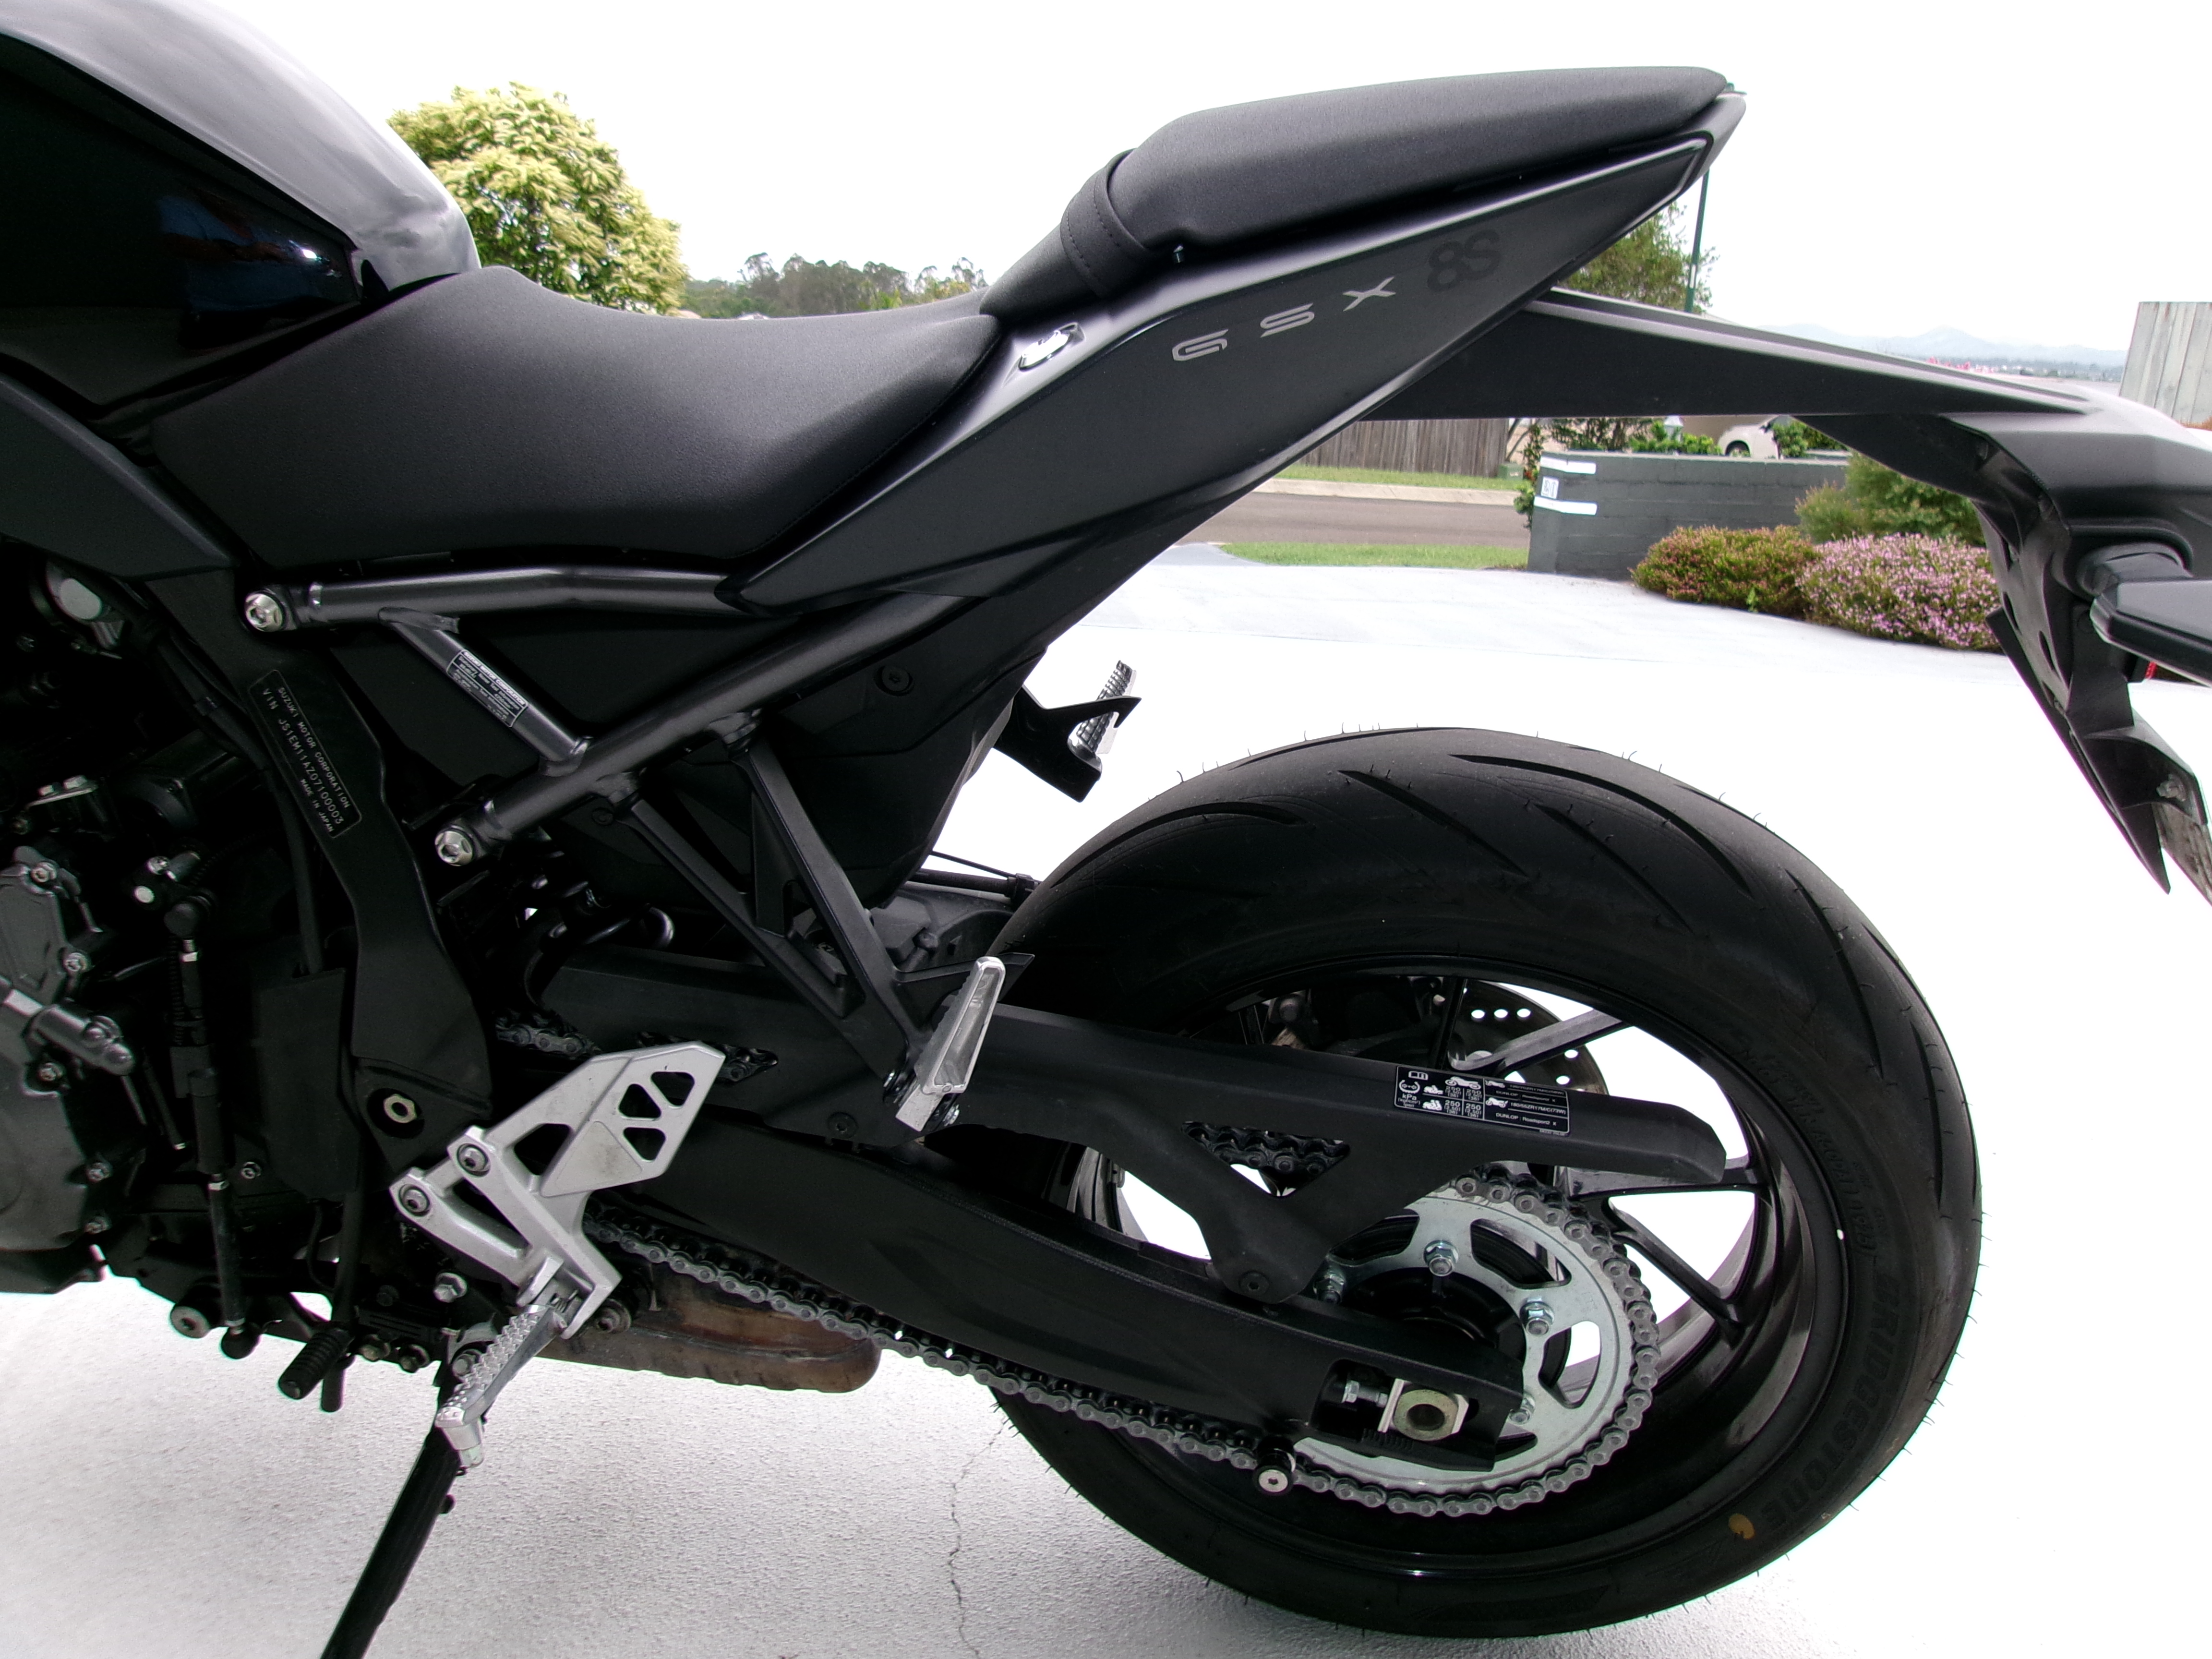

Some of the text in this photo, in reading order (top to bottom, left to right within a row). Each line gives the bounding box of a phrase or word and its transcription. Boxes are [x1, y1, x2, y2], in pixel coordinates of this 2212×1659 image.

[1427, 228, 1503, 292] 8S
[263, 688, 279, 709] VIN
[277, 687, 350, 808] SUZUKI MOTOR CORPORATION
[300, 779, 333, 832] MADE IN JAPAN
[1760, 1272, 1902, 1530] BRIDGESTONE
